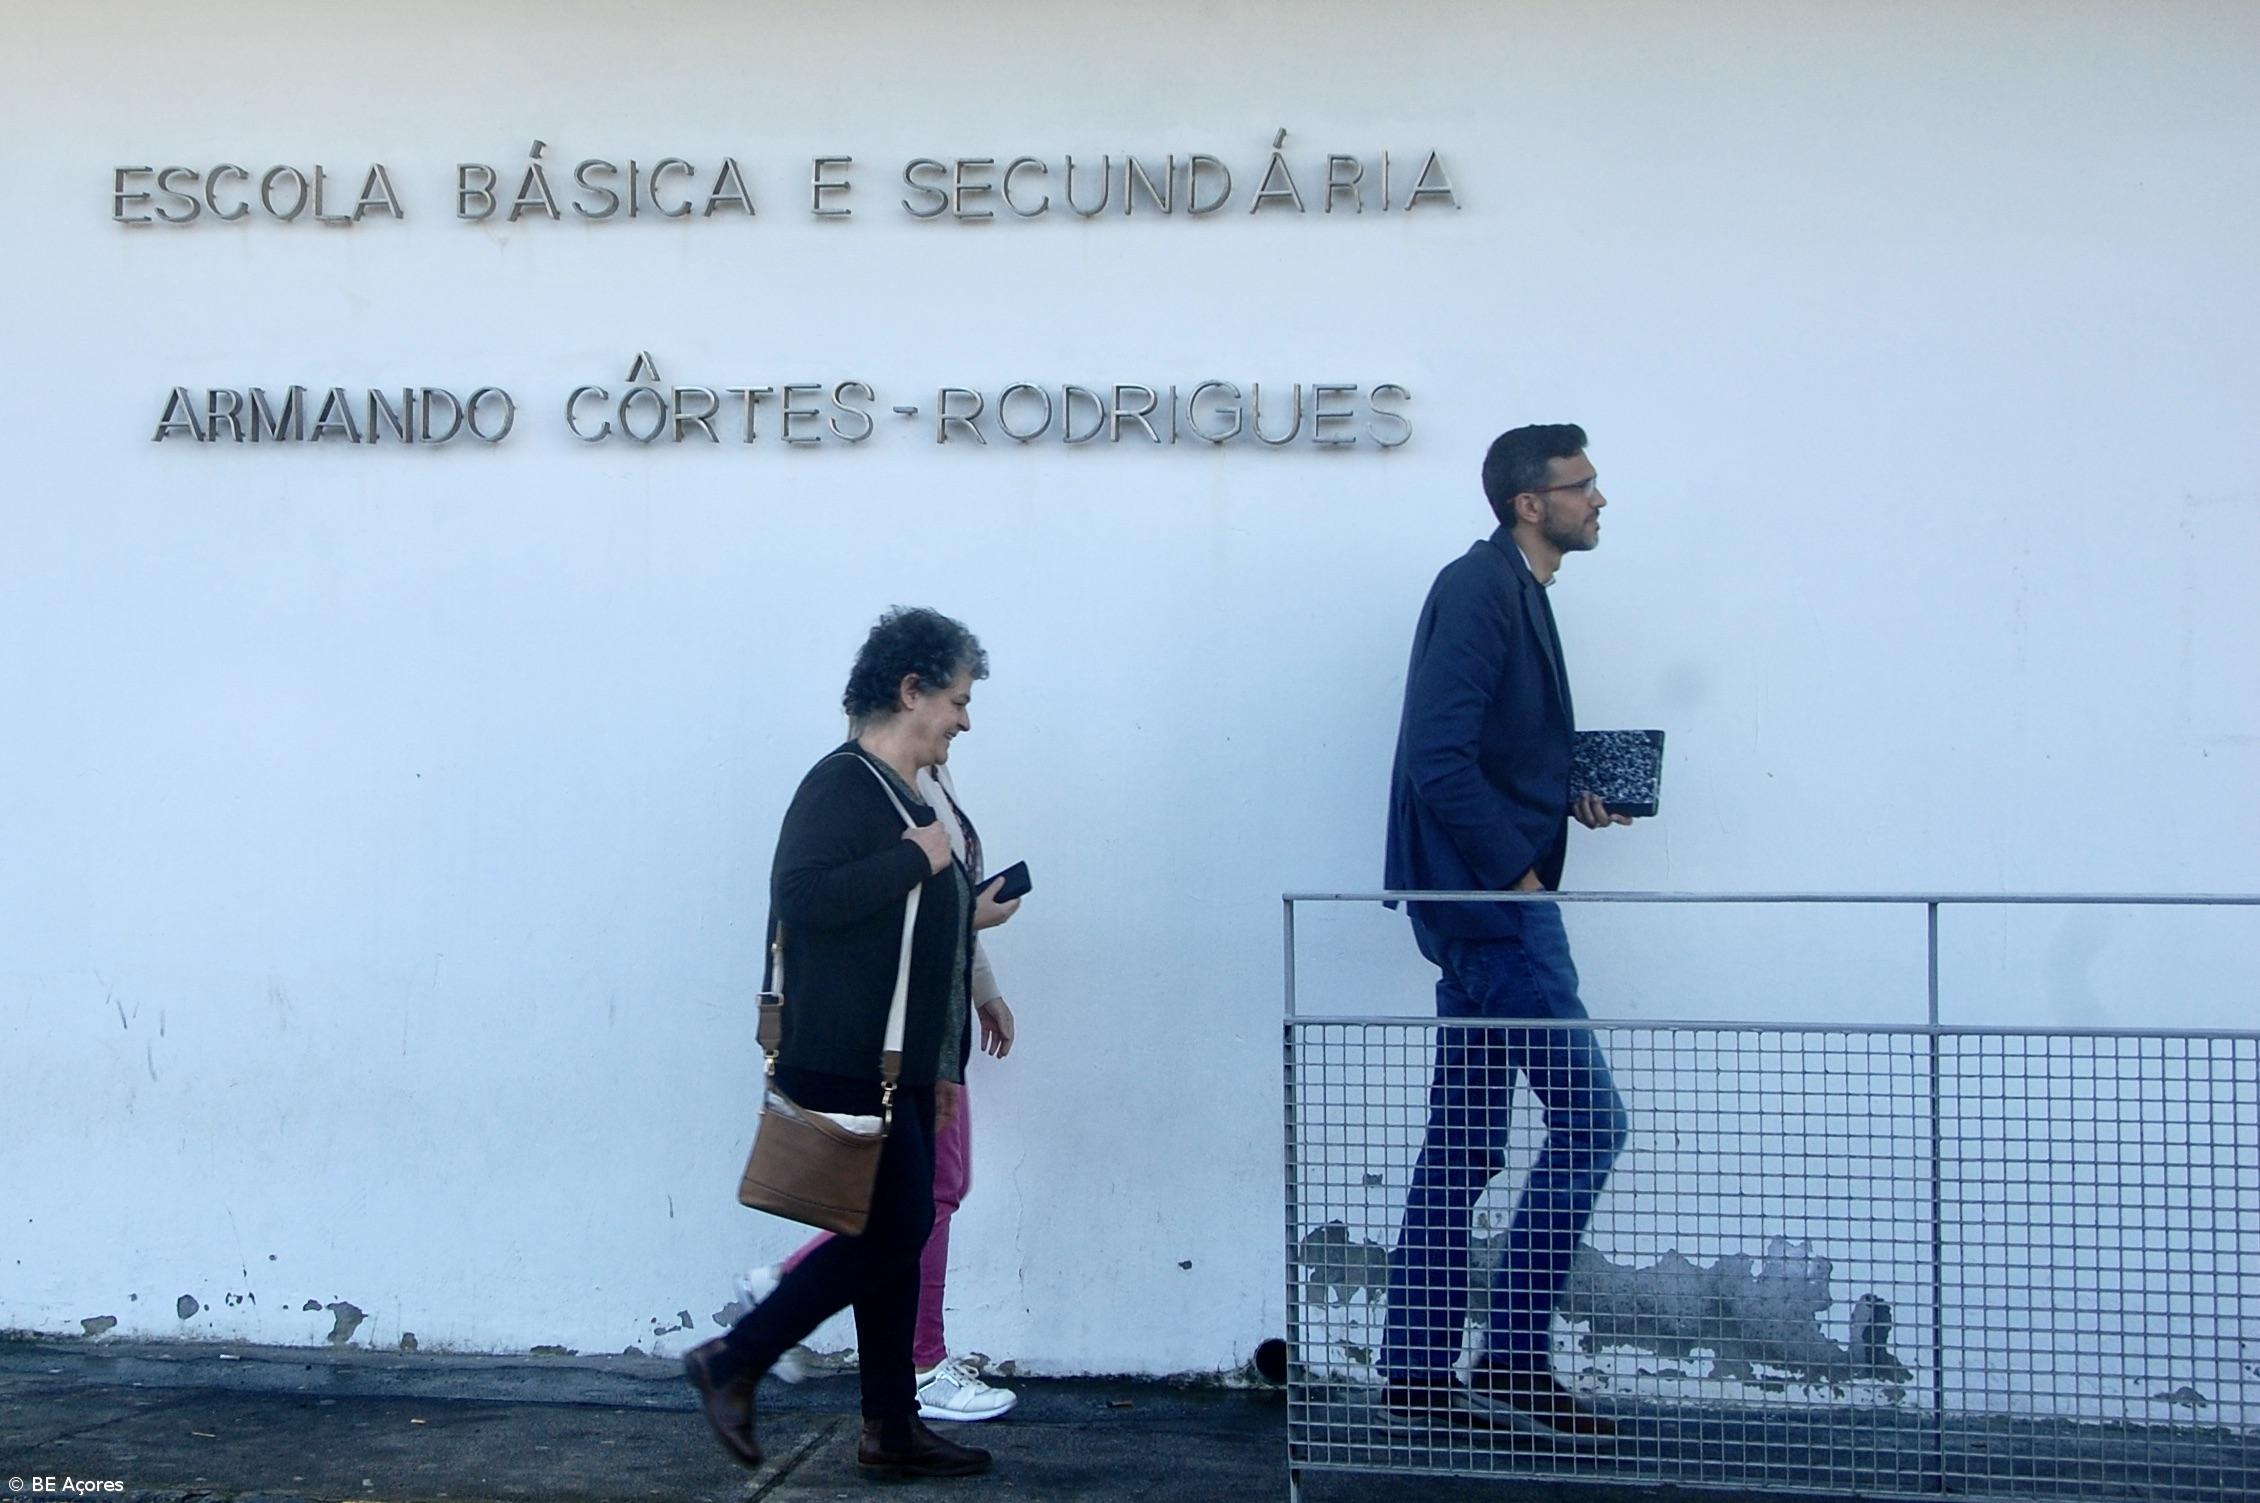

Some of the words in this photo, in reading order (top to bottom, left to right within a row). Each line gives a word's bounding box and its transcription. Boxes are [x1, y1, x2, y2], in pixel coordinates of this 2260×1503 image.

[112, 162, 405, 223] ESCOLA
[455, 139, 756, 222] BÁSICA
[811, 155, 852, 217] E
[901, 127, 1463, 219] SECUNDÁRIA
[151, 384, 517, 444] ARMANDO
